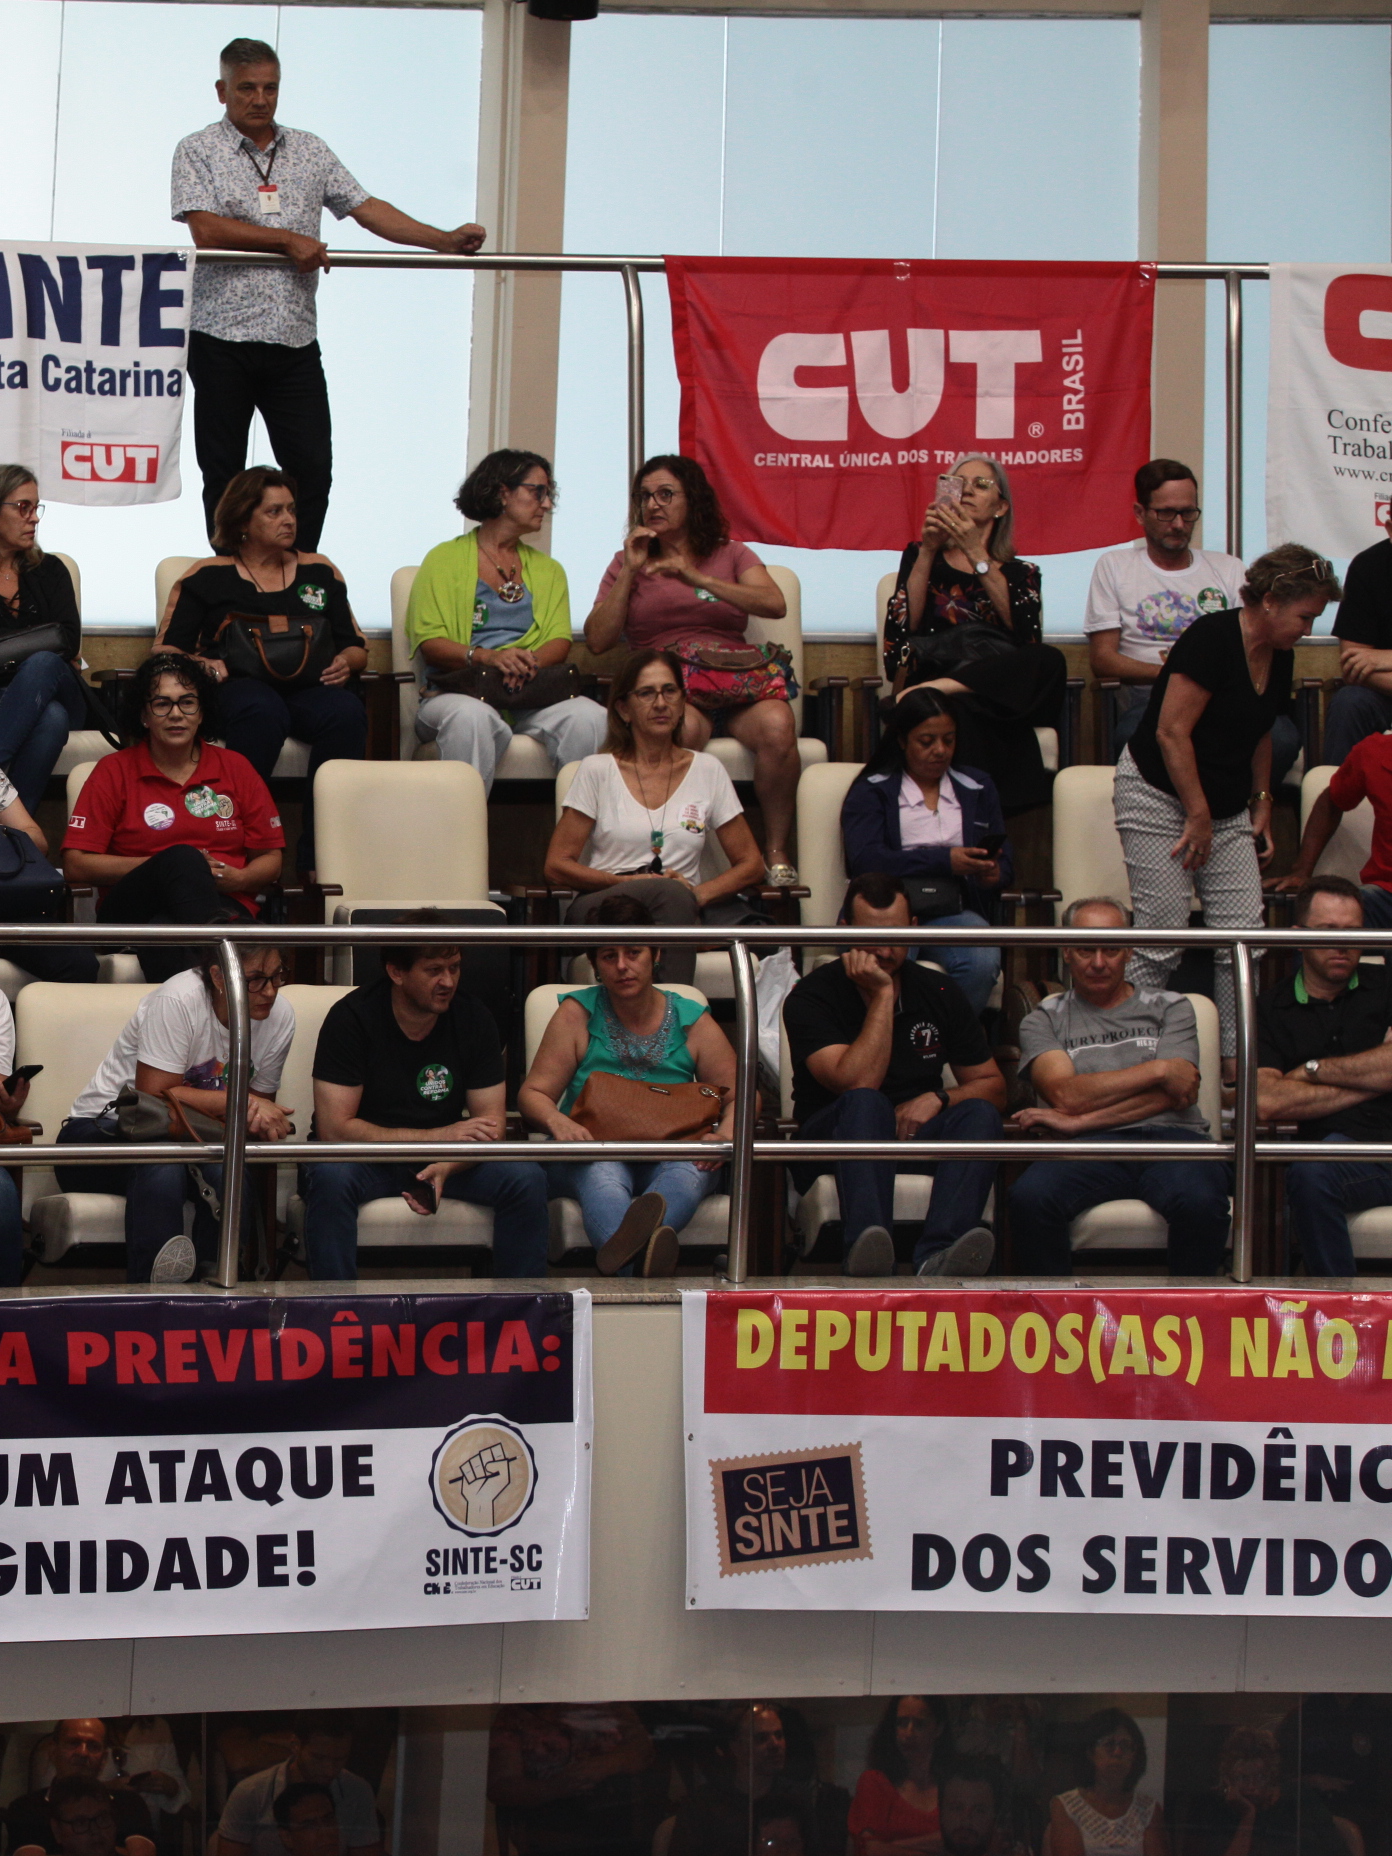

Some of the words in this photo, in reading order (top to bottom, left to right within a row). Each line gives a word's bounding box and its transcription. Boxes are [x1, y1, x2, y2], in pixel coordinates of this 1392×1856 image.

[41, 353, 183, 398] Catarina
[757, 328, 1043, 441] CUT
[1062, 329, 1084, 431] BRASIL
[61, 428, 85, 439] Filiada
[1327, 409, 1392, 434] Confe
[62, 443, 157, 482] CUT
[754, 452, 834, 468] CENTRAL
[839, 450, 893, 468] ÚNICA
[897, 449, 929, 465] DOS
[66, 1310, 562, 1385] PREVIDÊNCIA:
[736, 1308, 1204, 1386] DEPUTADOS(AS)
[1230, 1300, 1359, 1380] NÃO
[105, 1443, 375, 1507] ATAQUE
[742, 1466, 834, 1514] SEJA
[990, 1427, 1392, 1504] PREVIDÊNC
[734, 1503, 852, 1556] SINTE
[425, 1543, 543, 1577] SINTE-SC
[511, 1579, 540, 1590] CUT
[911, 1533, 1051, 1594] DOS
[1082, 1534, 1392, 1598] SERVIDO
